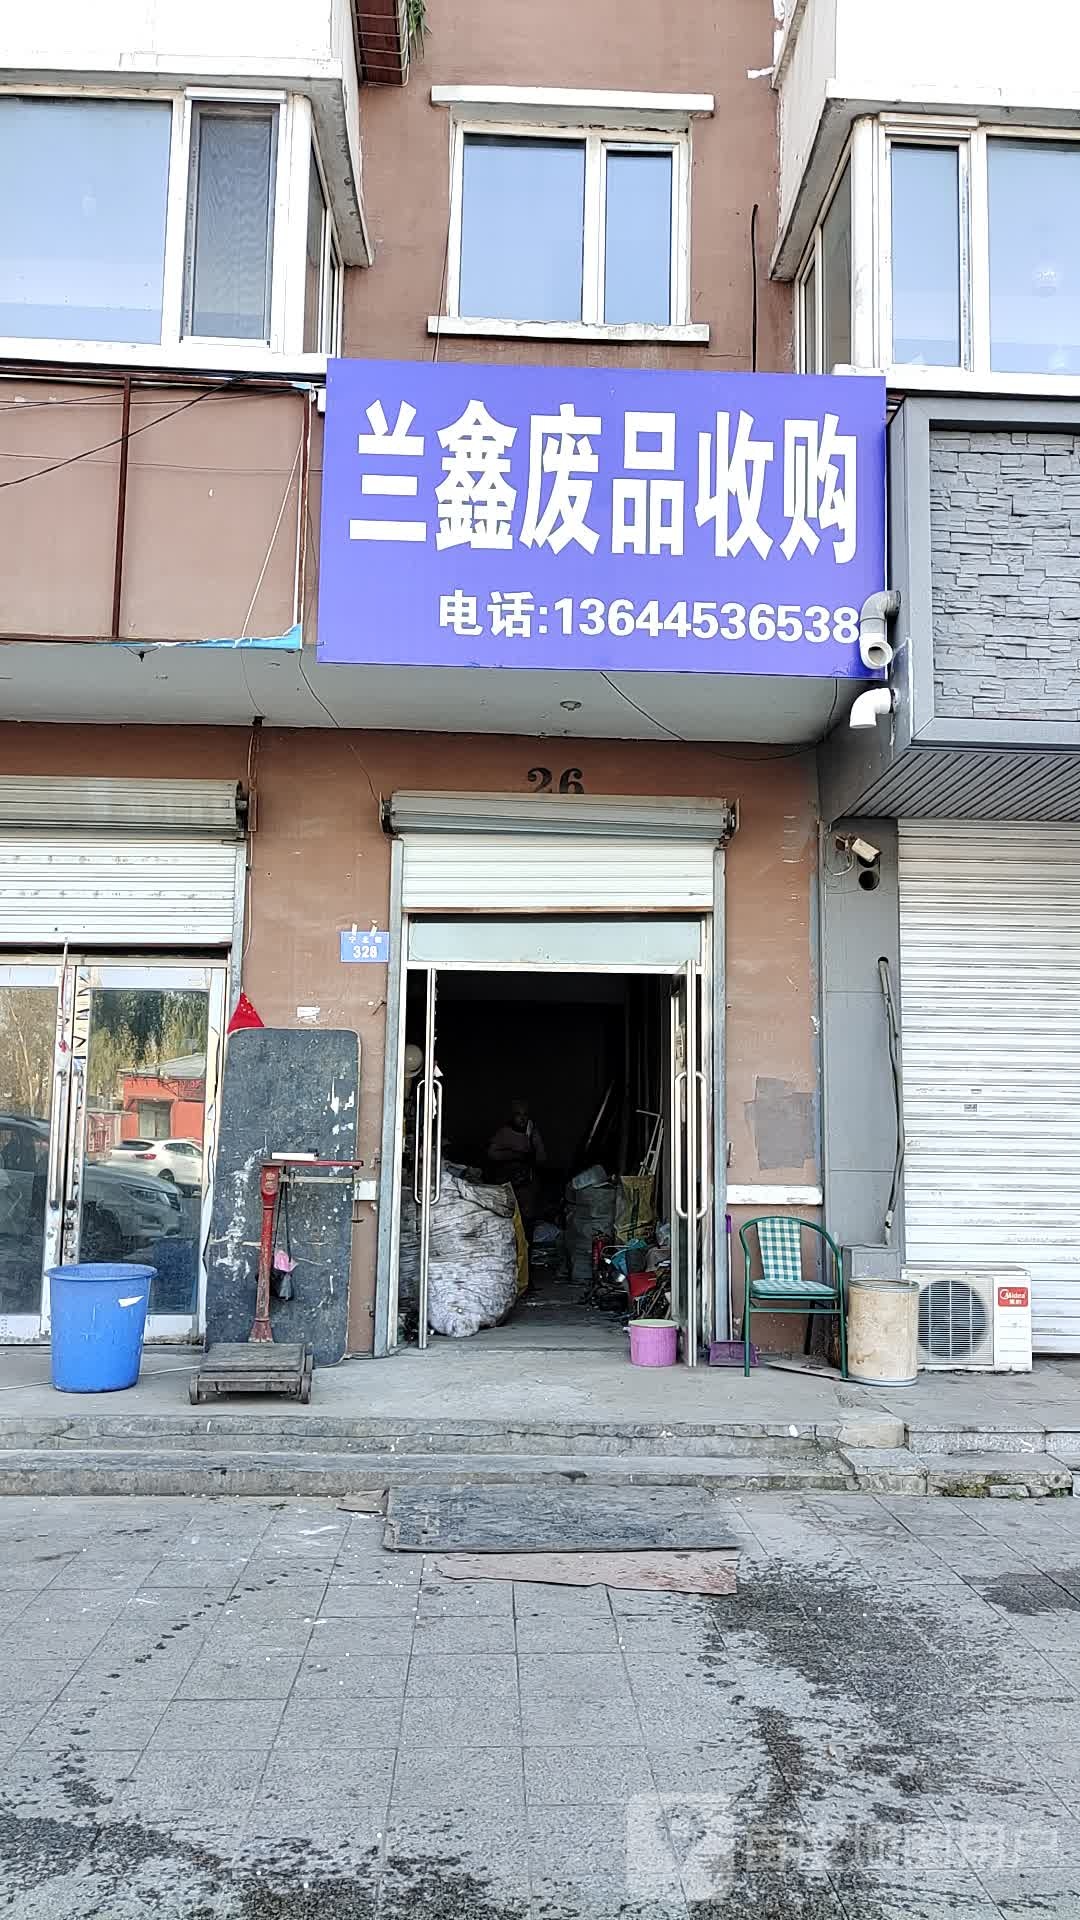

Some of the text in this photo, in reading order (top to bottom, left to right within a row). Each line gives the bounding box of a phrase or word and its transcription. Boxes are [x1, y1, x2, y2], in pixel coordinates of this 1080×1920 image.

[349, 400, 857, 564] 兰鑫废品收购
[438, 589, 859, 644] 电话:13644536538
